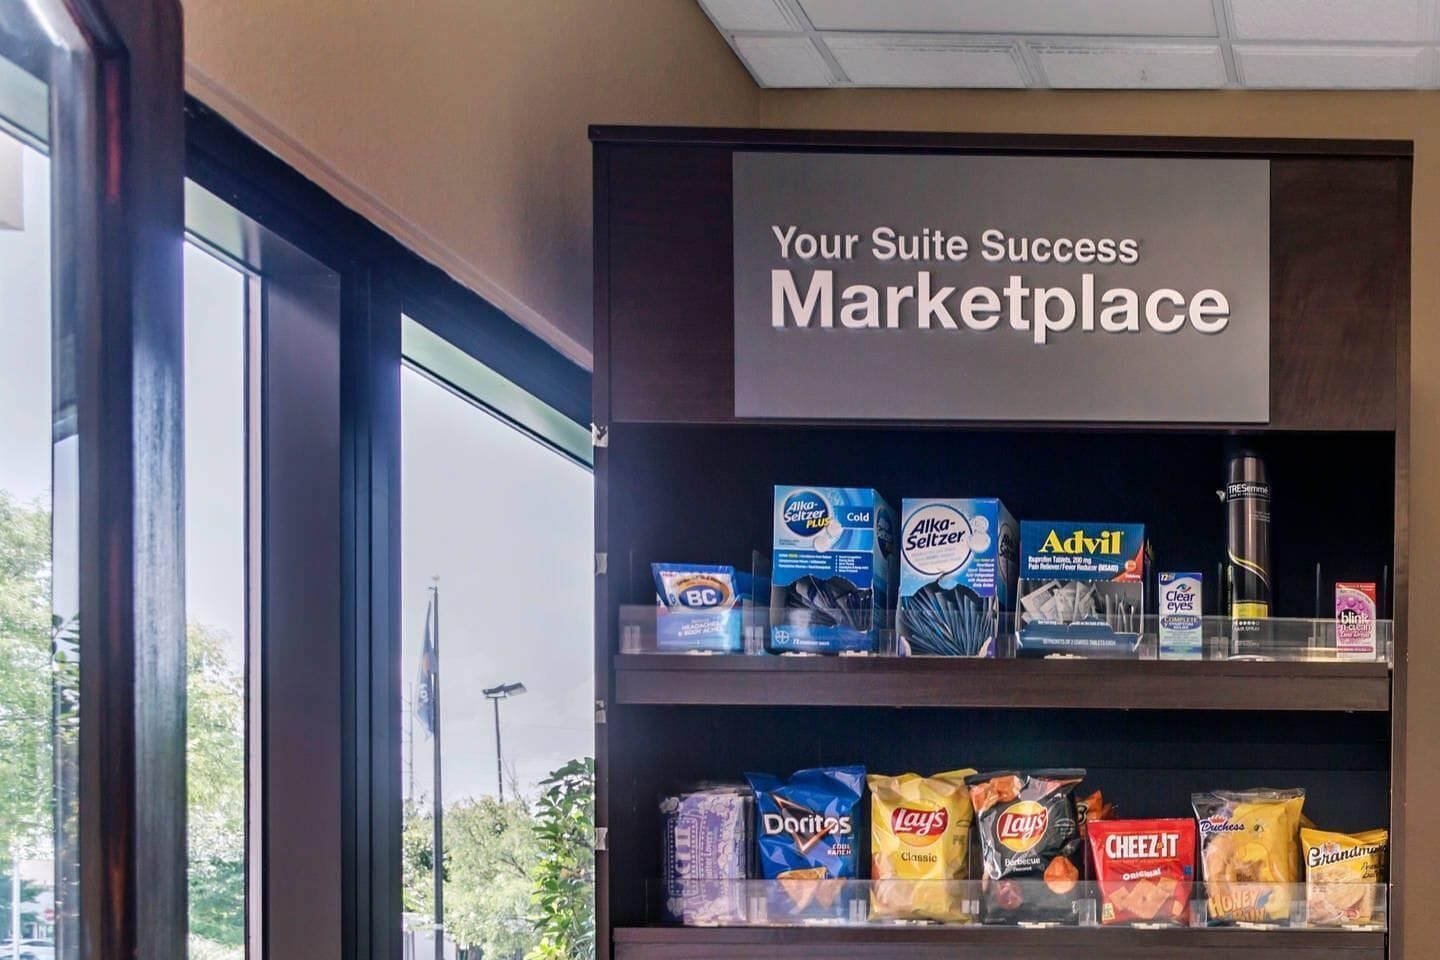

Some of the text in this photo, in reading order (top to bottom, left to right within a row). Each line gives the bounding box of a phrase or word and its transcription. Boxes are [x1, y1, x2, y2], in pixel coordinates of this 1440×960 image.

[772, 226, 1140, 265] Your Suite Success
[771, 270, 1229, 344] Marketplace
[787, 501, 818, 513] Alka-
[784, 509, 826, 523] Seltzer
[806, 516, 831, 529] PLUS
[847, 512, 870, 521] Cold
[910, 518, 956, 535] Alka-
[905, 531, 965, 551] Seltzer
[1038, 529, 1121, 555] Advil
[687, 589, 717, 606] BC
[1166, 591, 1195, 602] Clear
[1167, 602, 1193, 613] eyes
[1341, 611, 1368, 625] blink
[764, 814, 852, 835] Doritos
[1200, 819, 1246, 833] Duchess
[901, 852, 938, 863] Classic
[1005, 857, 1041, 867] Barbecue
